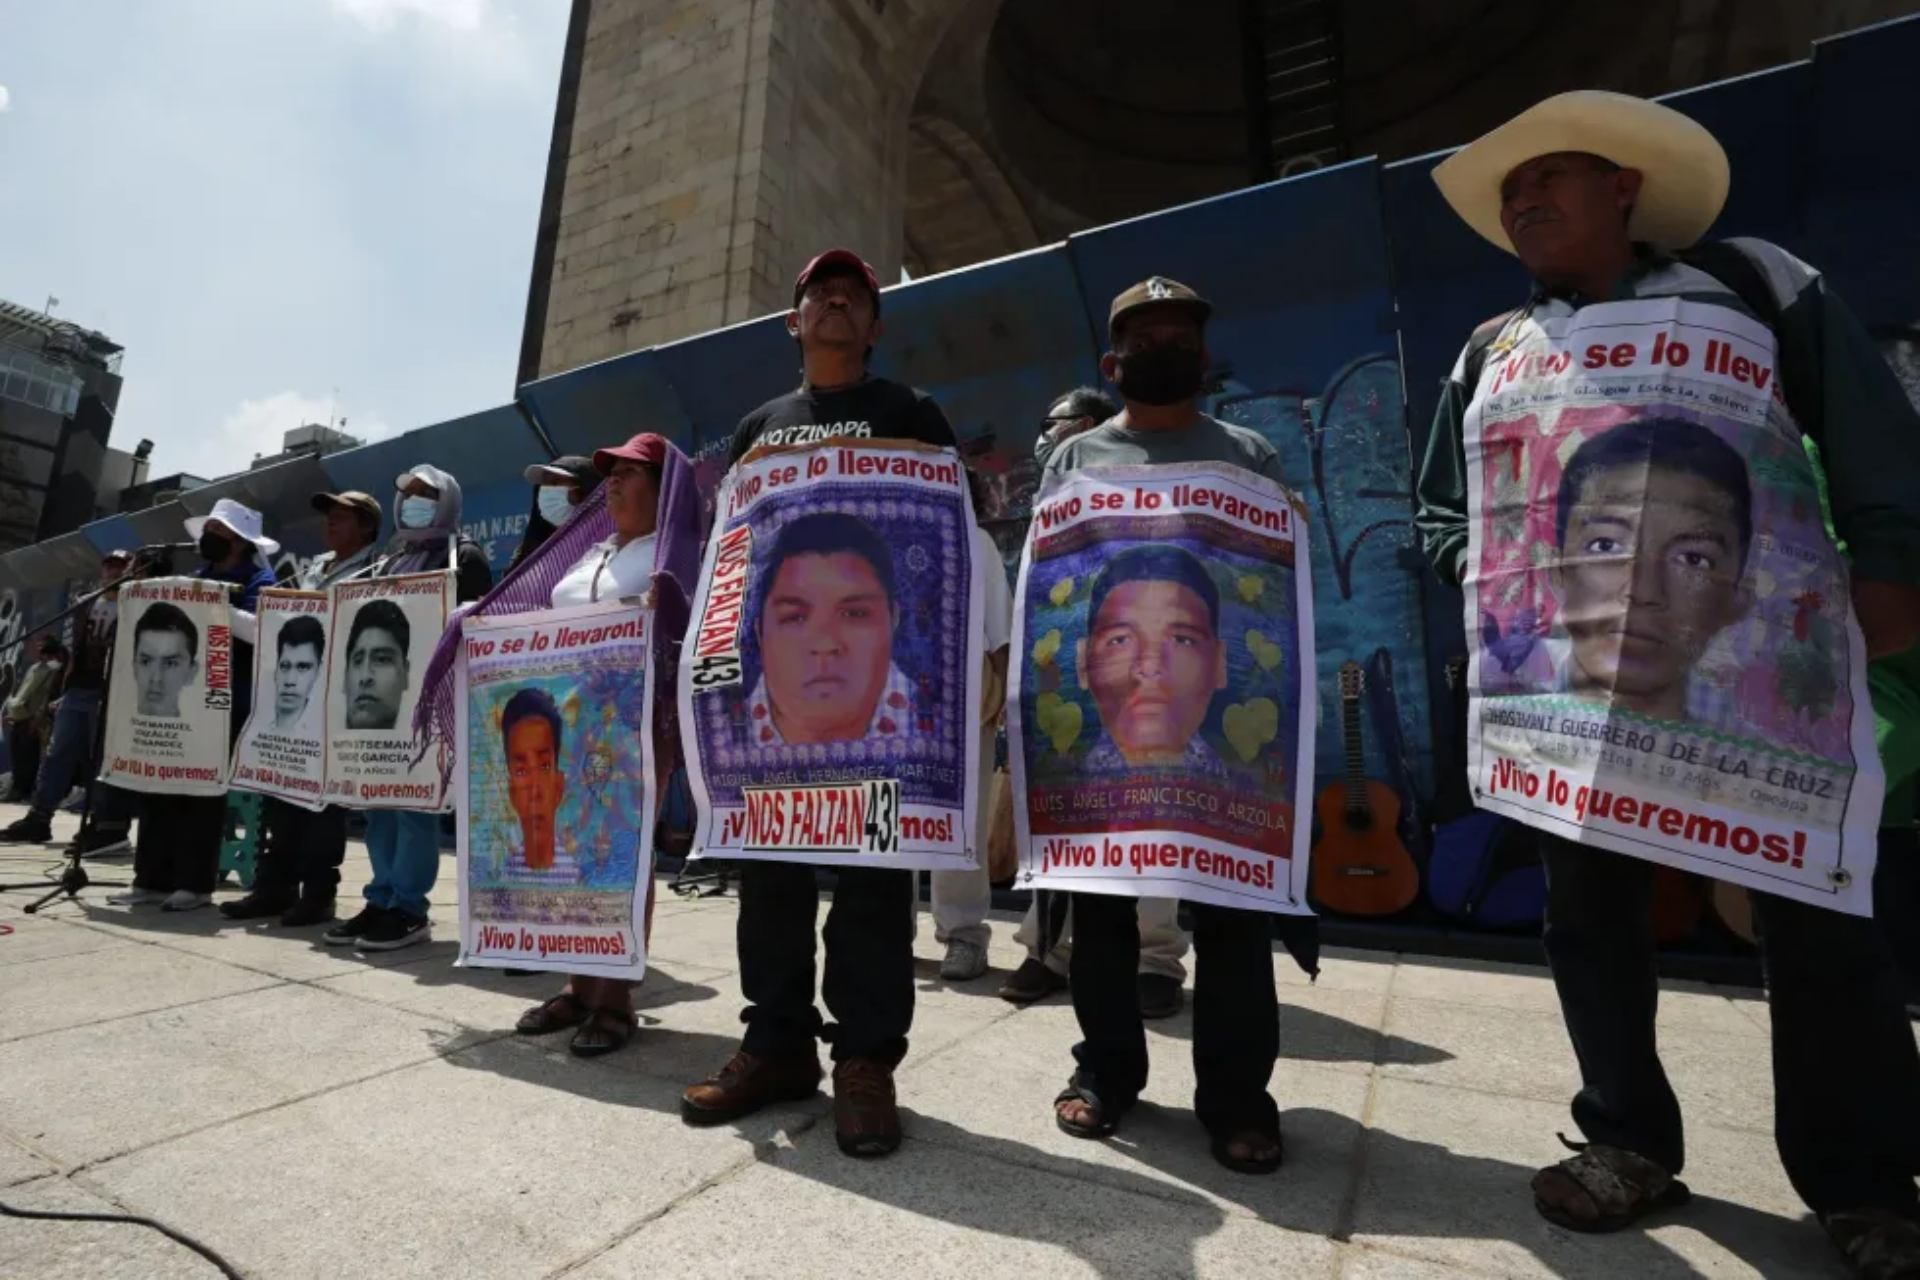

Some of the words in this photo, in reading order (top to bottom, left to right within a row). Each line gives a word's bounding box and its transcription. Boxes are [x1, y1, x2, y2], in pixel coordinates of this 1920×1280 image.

[1146, 279, 1172, 299] LA
[1583, 341, 1637, 369] se
[1651, 331, 1690, 368] lo
[767, 464, 798, 488] se
[806, 454, 829, 479] lo
[838, 449, 960, 487] llevaron!
[1034, 496, 1082, 538] ¡Vivo
[1089, 490, 1125, 511] se
[1134, 487, 1162, 510] lo
[1172, 484, 1289, 533] llevaron!
[714, 526, 748, 578] NOS
[290, 600, 305, 612] se
[305, 600, 318, 612] lo
[697, 576, 744, 658] FALTAN
[207, 624, 231, 648] NOS
[499, 638, 525, 654] se
[529, 631, 550, 652] lo
[554, 616, 645, 650] llevaron!
[207, 651, 231, 688] FALTAN
[205, 688, 231, 710] 43!
[144, 761, 156, 777] lo
[158, 765, 219, 782] queremos!
[1560, 717, 1656, 754] GUERRERO
[1668, 741, 1701, 765] DE
[1717, 753, 1750, 779] LA
[1766, 766, 1833, 799] CRUZ
[360, 781, 435, 801] queremos!
[1123, 786, 1219, 813] FRANCISCO
[1227, 801, 1287, 833] ARZOLA
[745, 790, 786, 846] NOS
[788, 788, 865, 847] FALTAN
[864, 780, 899, 853] 43!
[899, 813, 953, 843] mos!
[1490, 757, 1540, 798] ¡Vivo
[1546, 768, 1570, 807] lo
[1574, 784, 1807, 869] queremos!
[1041, 838, 1096, 874] ¡Vivo
[1102, 837, 1124, 868] lo
[1129, 842, 1275, 890] queremos!
[477, 925, 516, 954] ¡Vivo
[519, 927, 534, 952] lo
[538, 931, 626, 958] queremos!
